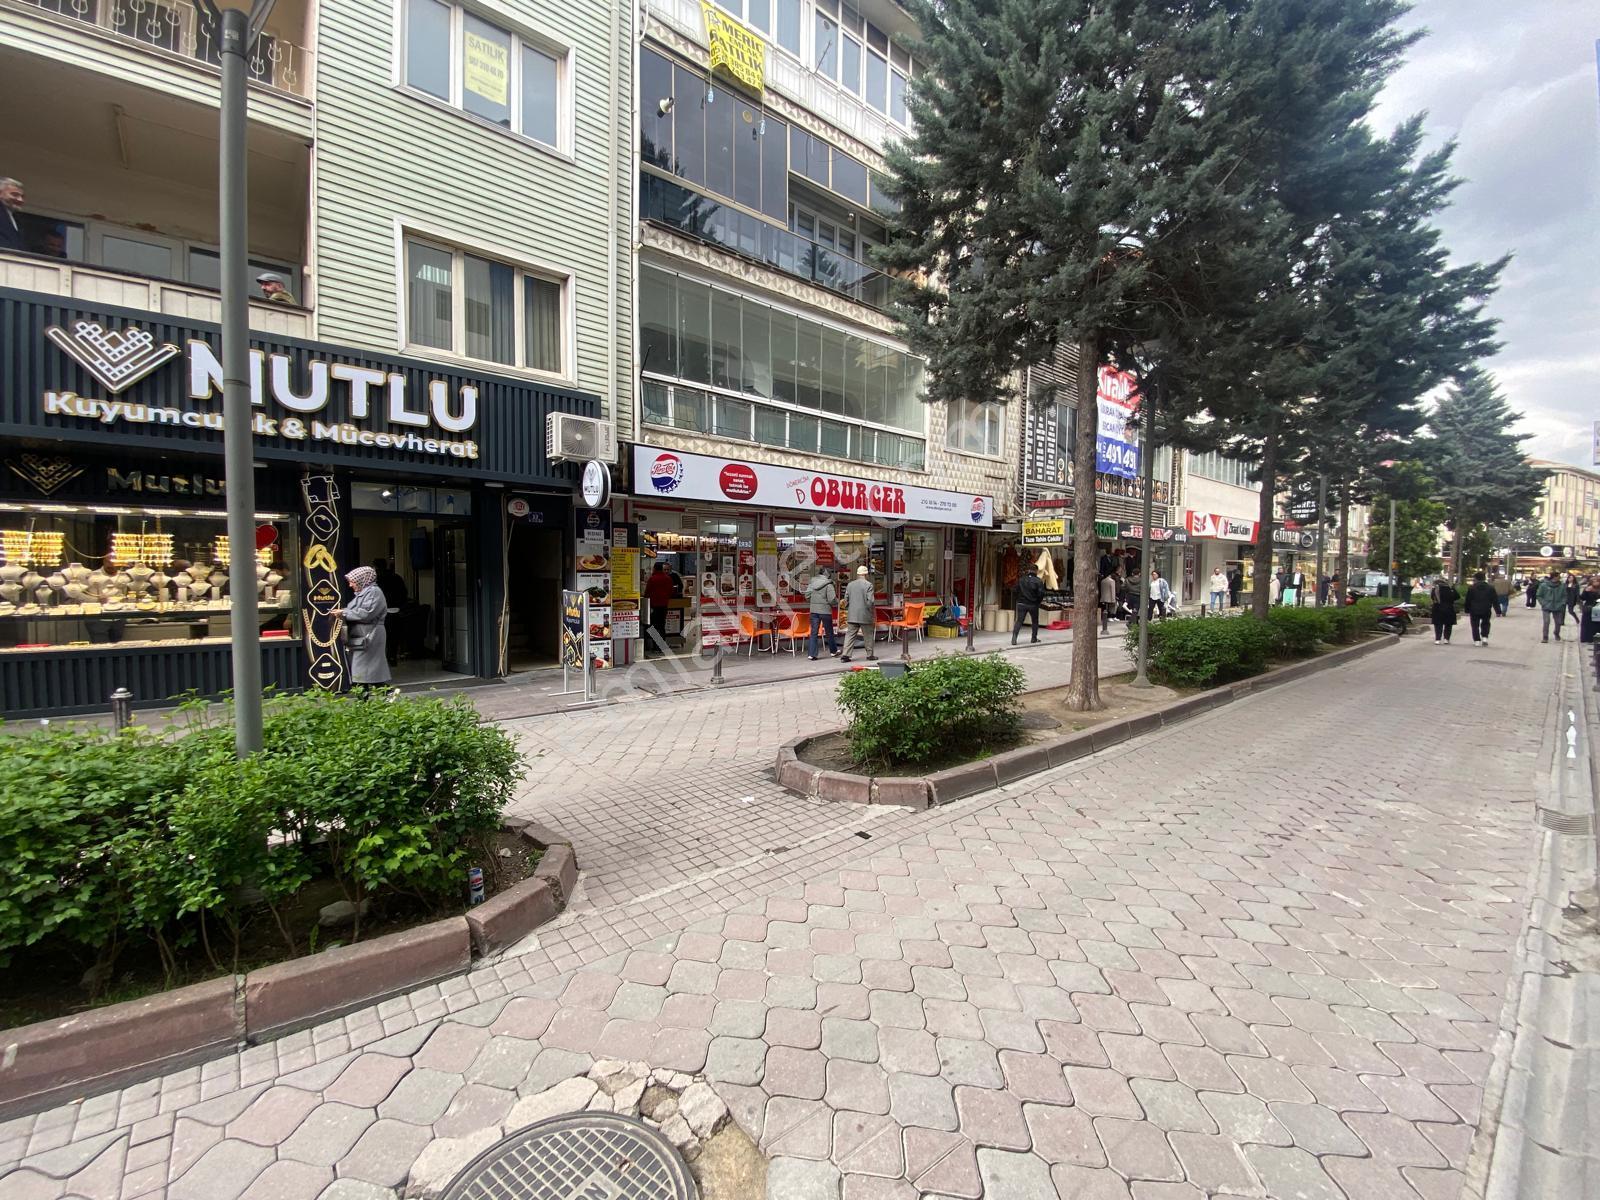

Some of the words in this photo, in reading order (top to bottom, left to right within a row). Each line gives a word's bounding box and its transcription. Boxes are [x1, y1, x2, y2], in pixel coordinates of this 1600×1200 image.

[469, 36, 505, 64] SATILIK
[188, 339, 479, 432] MUTLU
[45, 391, 277, 436] Kuyumcuk
[282, 418, 307, 439] &
[313, 420, 479, 460] Mücevherat
[811, 476, 906, 514] OBURGER
[1025, 527, 1062, 535] BAHARAT
